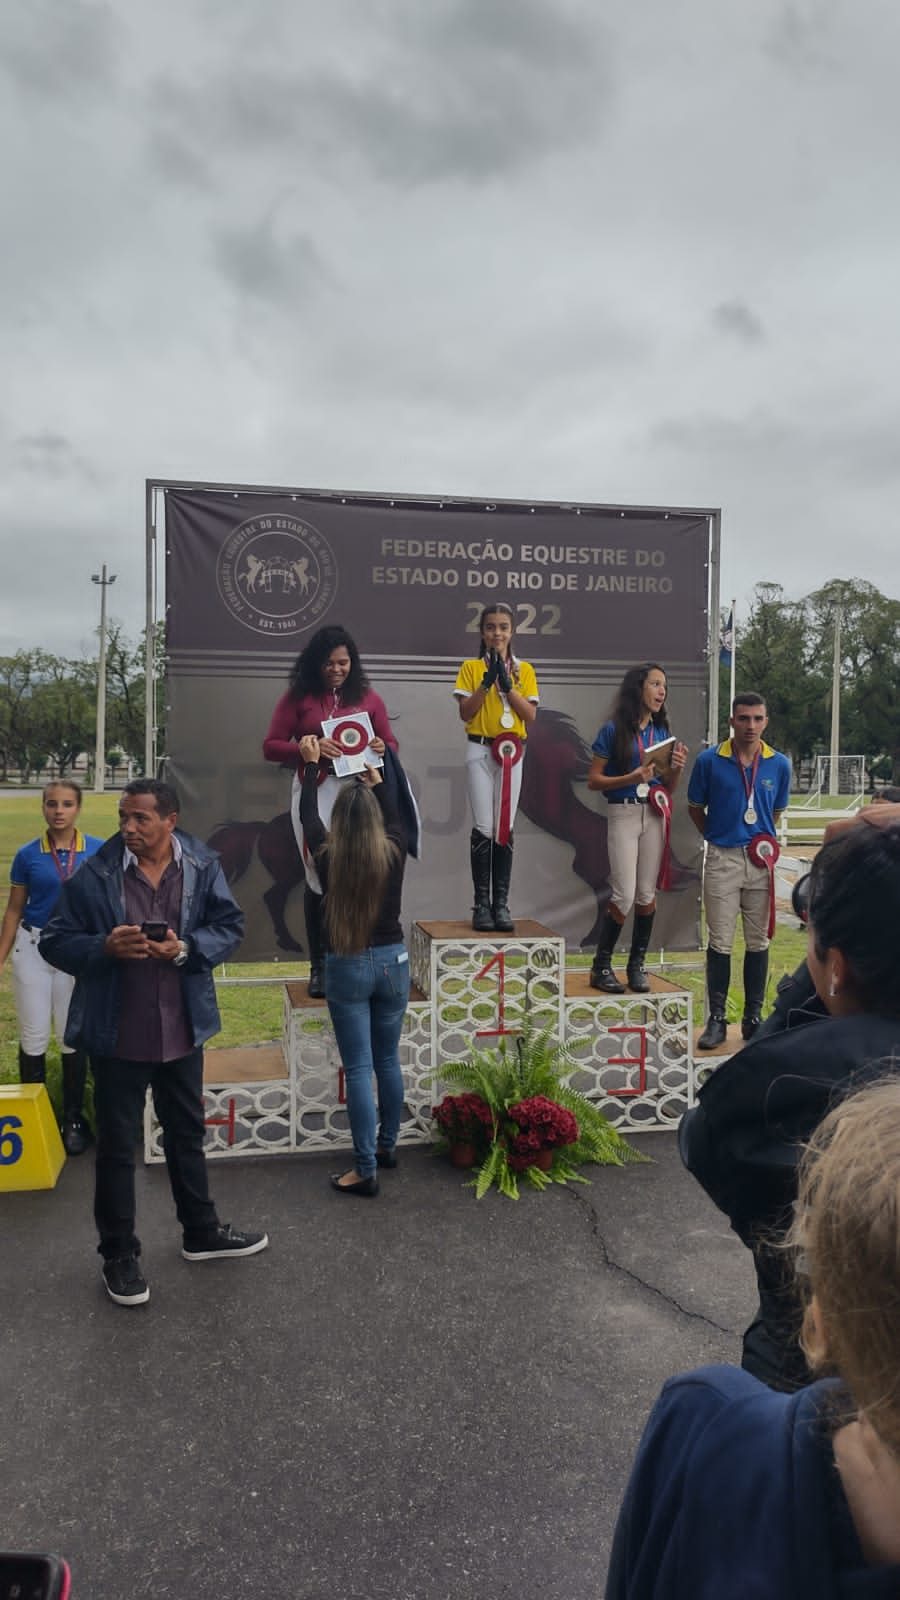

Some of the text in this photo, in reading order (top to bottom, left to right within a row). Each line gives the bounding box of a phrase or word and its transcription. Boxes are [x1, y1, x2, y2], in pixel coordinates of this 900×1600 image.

[381, 538, 666, 567] FEDERAÇÃO EQUESTRE DO
[372, 566, 673, 594] ESTADO DO RIO DE JANEIRO
[465, 602, 561, 635] 222
[475, 951, 521, 1037] 1
[608, 1027, 646, 1096] 3
[0, 1115, 24, 1165] 6
